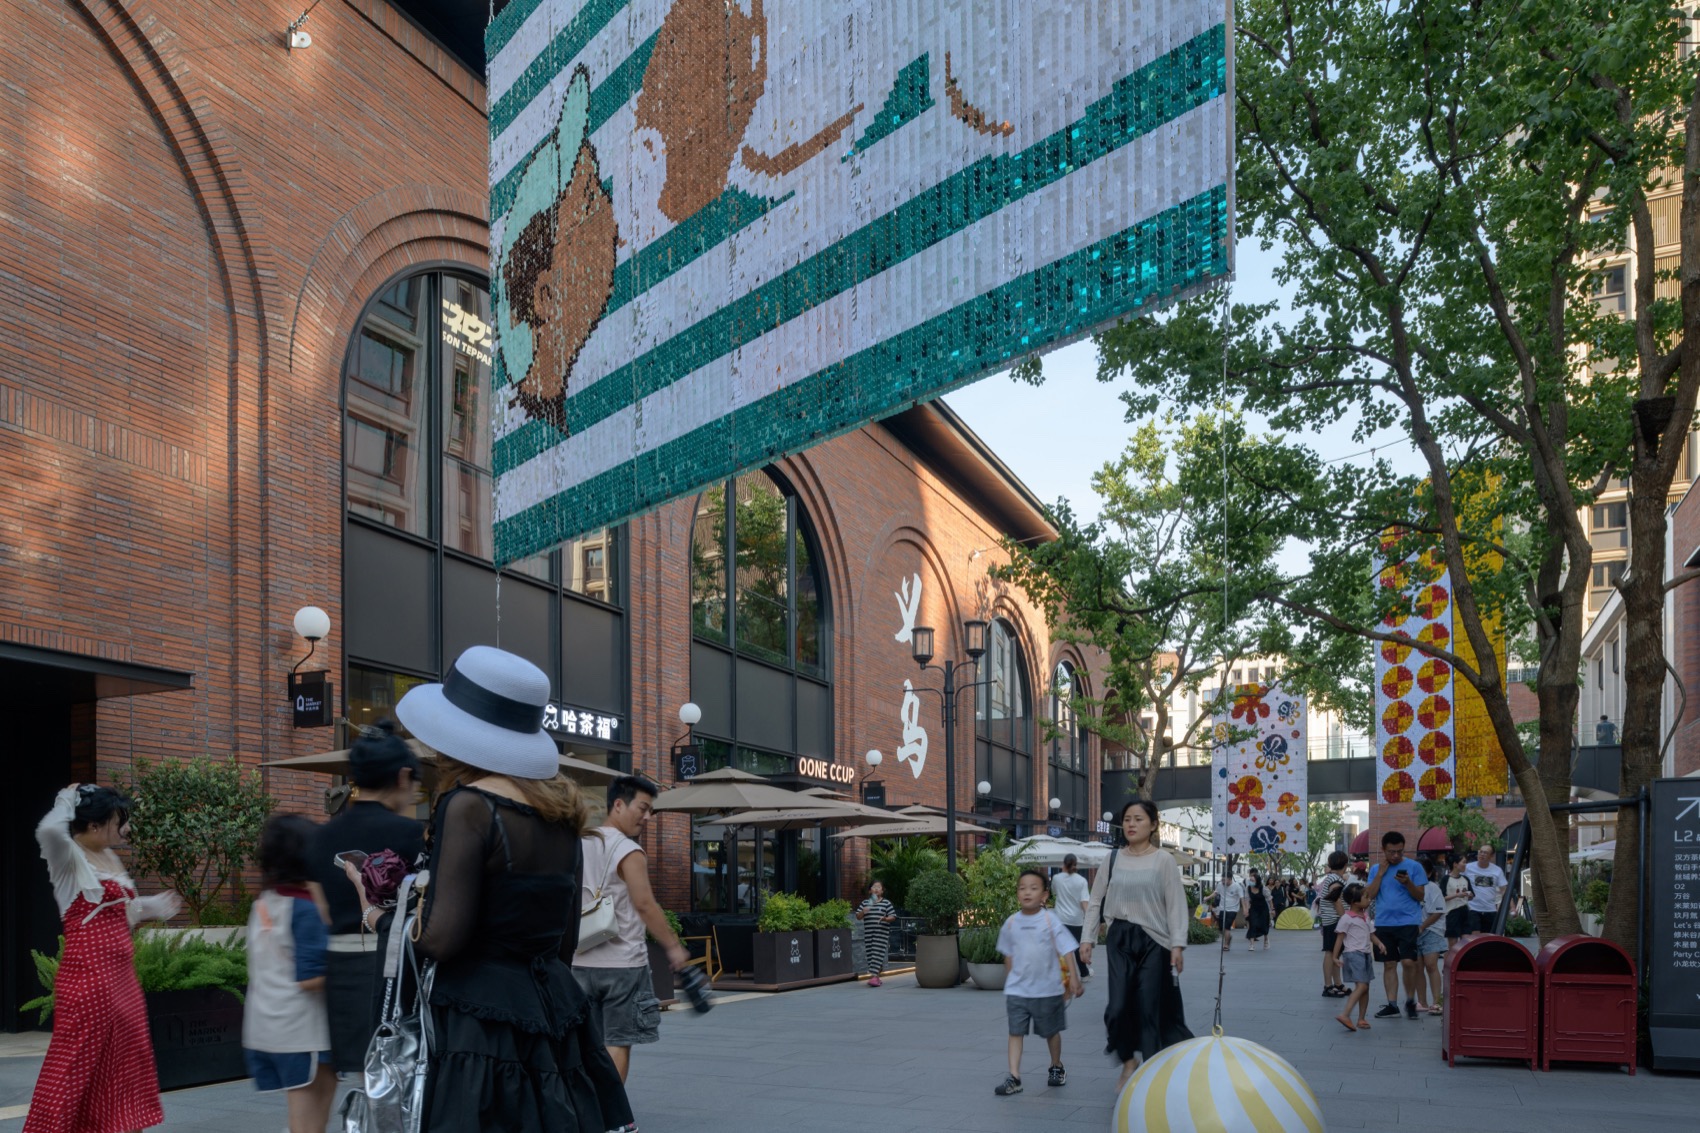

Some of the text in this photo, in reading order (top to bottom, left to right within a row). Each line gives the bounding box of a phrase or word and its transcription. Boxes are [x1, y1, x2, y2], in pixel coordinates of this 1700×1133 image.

[562, 709, 611, 740] 哈茶福
[799, 757, 855, 784] OONE CCUP
[1674, 830, 1693, 842] L2
[1674, 853, 1700, 861] 汉方茶
[1674, 902, 1700, 910] 米莱知
[1673, 921, 1692, 929] Let's
[1673, 950, 1692, 959] Party
